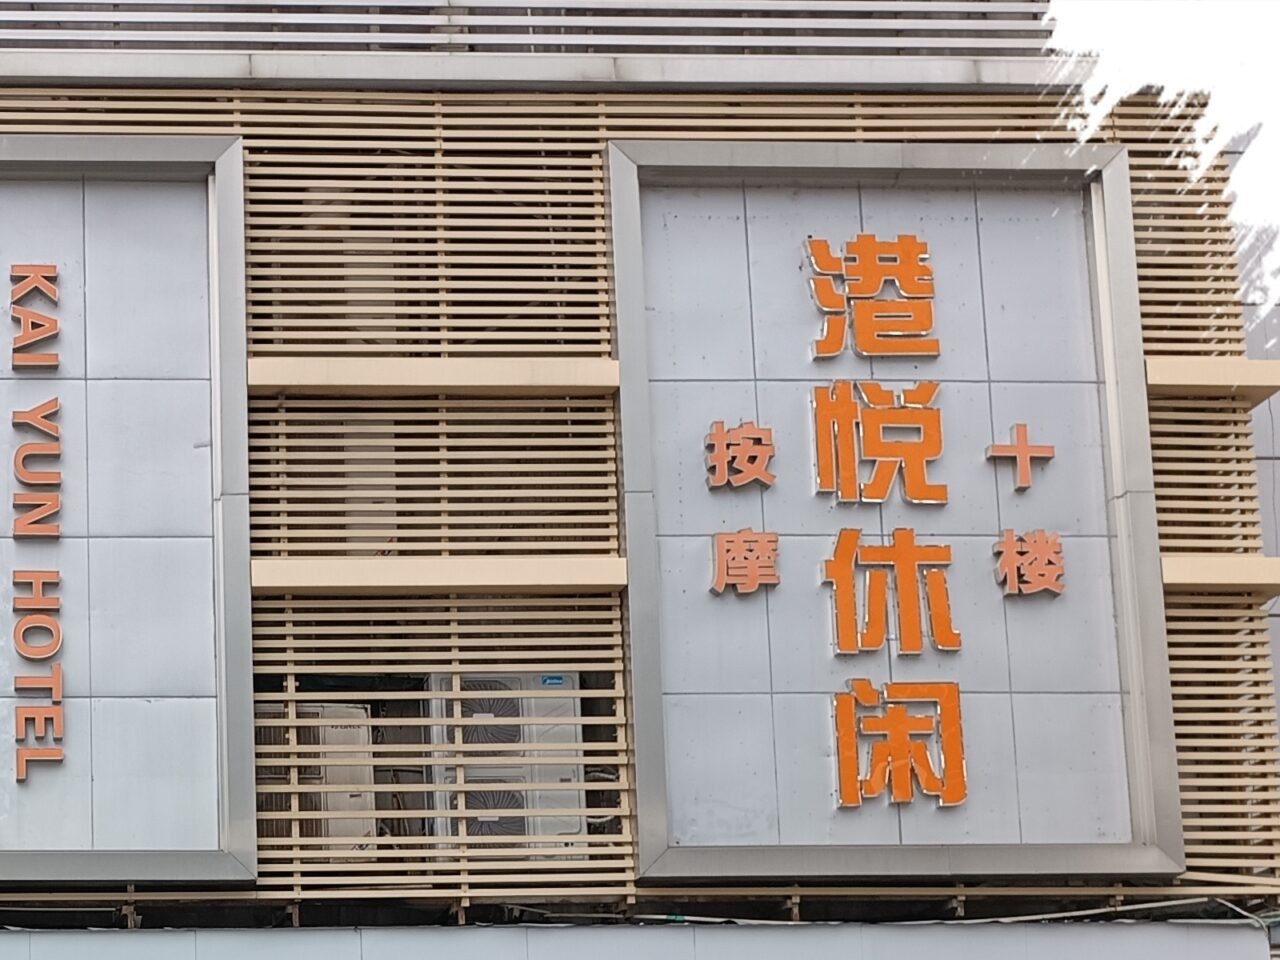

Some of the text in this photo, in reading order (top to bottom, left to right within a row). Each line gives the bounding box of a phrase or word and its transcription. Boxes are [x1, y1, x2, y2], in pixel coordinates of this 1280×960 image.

[9, 263, 65, 783] KAI YUN HOTEL
[704, 420, 781, 596] 按摩
[804, 233, 968, 809] 港悦休闲
[985, 423, 1067, 599] 十楼
